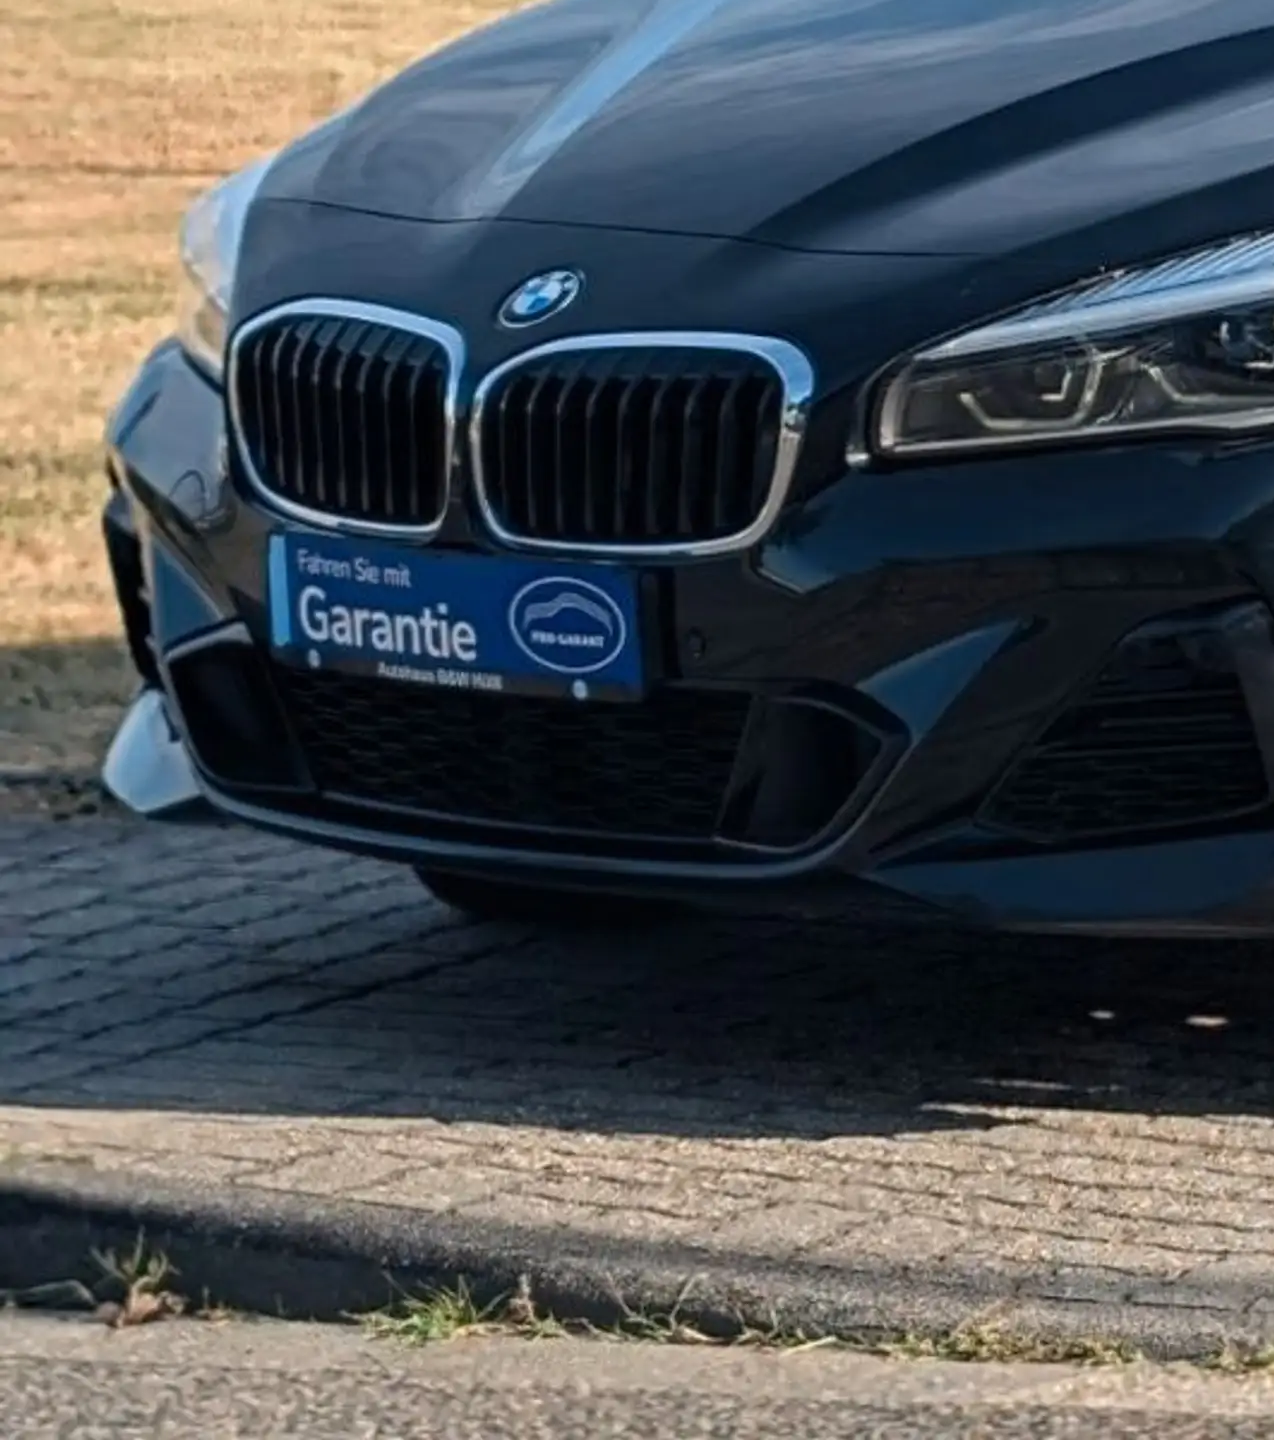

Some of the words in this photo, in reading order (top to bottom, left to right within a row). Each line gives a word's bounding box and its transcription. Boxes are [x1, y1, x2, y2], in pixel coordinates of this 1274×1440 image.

[297, 548, 351, 580] Fahren
[354, 556, 380, 585] Sie
[383, 563, 412, 588] mit
[300, 584, 478, 662] Garantie
